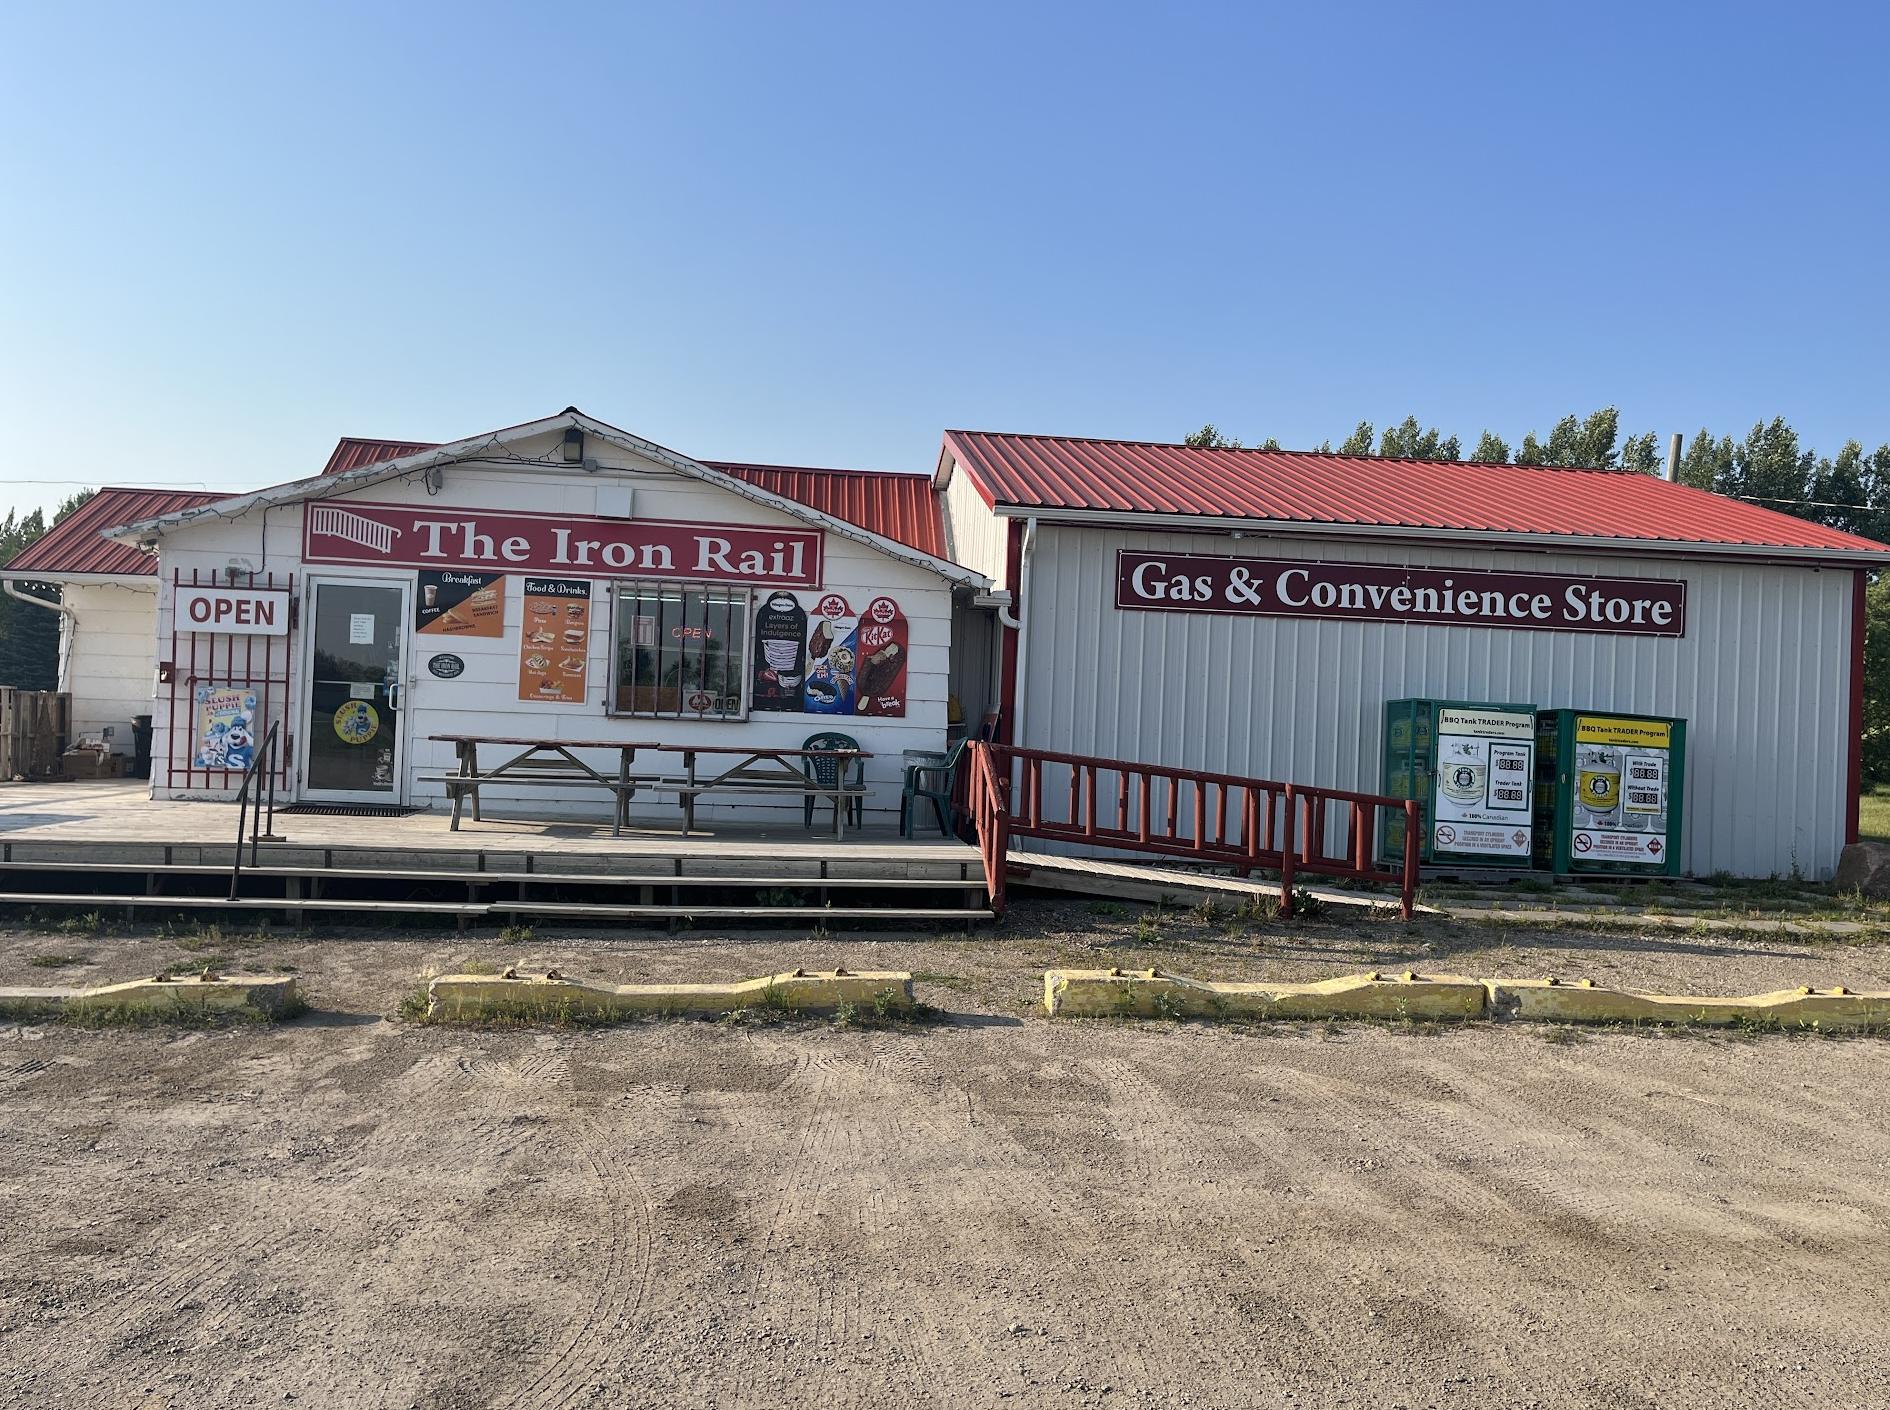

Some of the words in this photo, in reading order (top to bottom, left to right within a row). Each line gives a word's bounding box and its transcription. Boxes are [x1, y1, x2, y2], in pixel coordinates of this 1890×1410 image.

[413, 520, 530, 561] The
[550, 528, 676, 570] Iron
[692, 536, 806, 578] Rail
[442, 572, 481, 586] Breakfast
[526, 582, 546, 592] Food
[548, 584, 555, 593] &
[1132, 562, 1212, 602] Gas
[1225, 566, 1262, 606] &
[1276, 570, 1552, 619] Convenience
[1562, 585, 1673, 626] Store
[189, 597, 274, 626] OPEN
[672, 627, 712, 638] OPEN
[761, 630, 801, 638] Indulgence
[765, 622, 788, 630] Layers
[864, 626, 891, 645] KitKat
[336, 702, 357, 725] SLUSH
